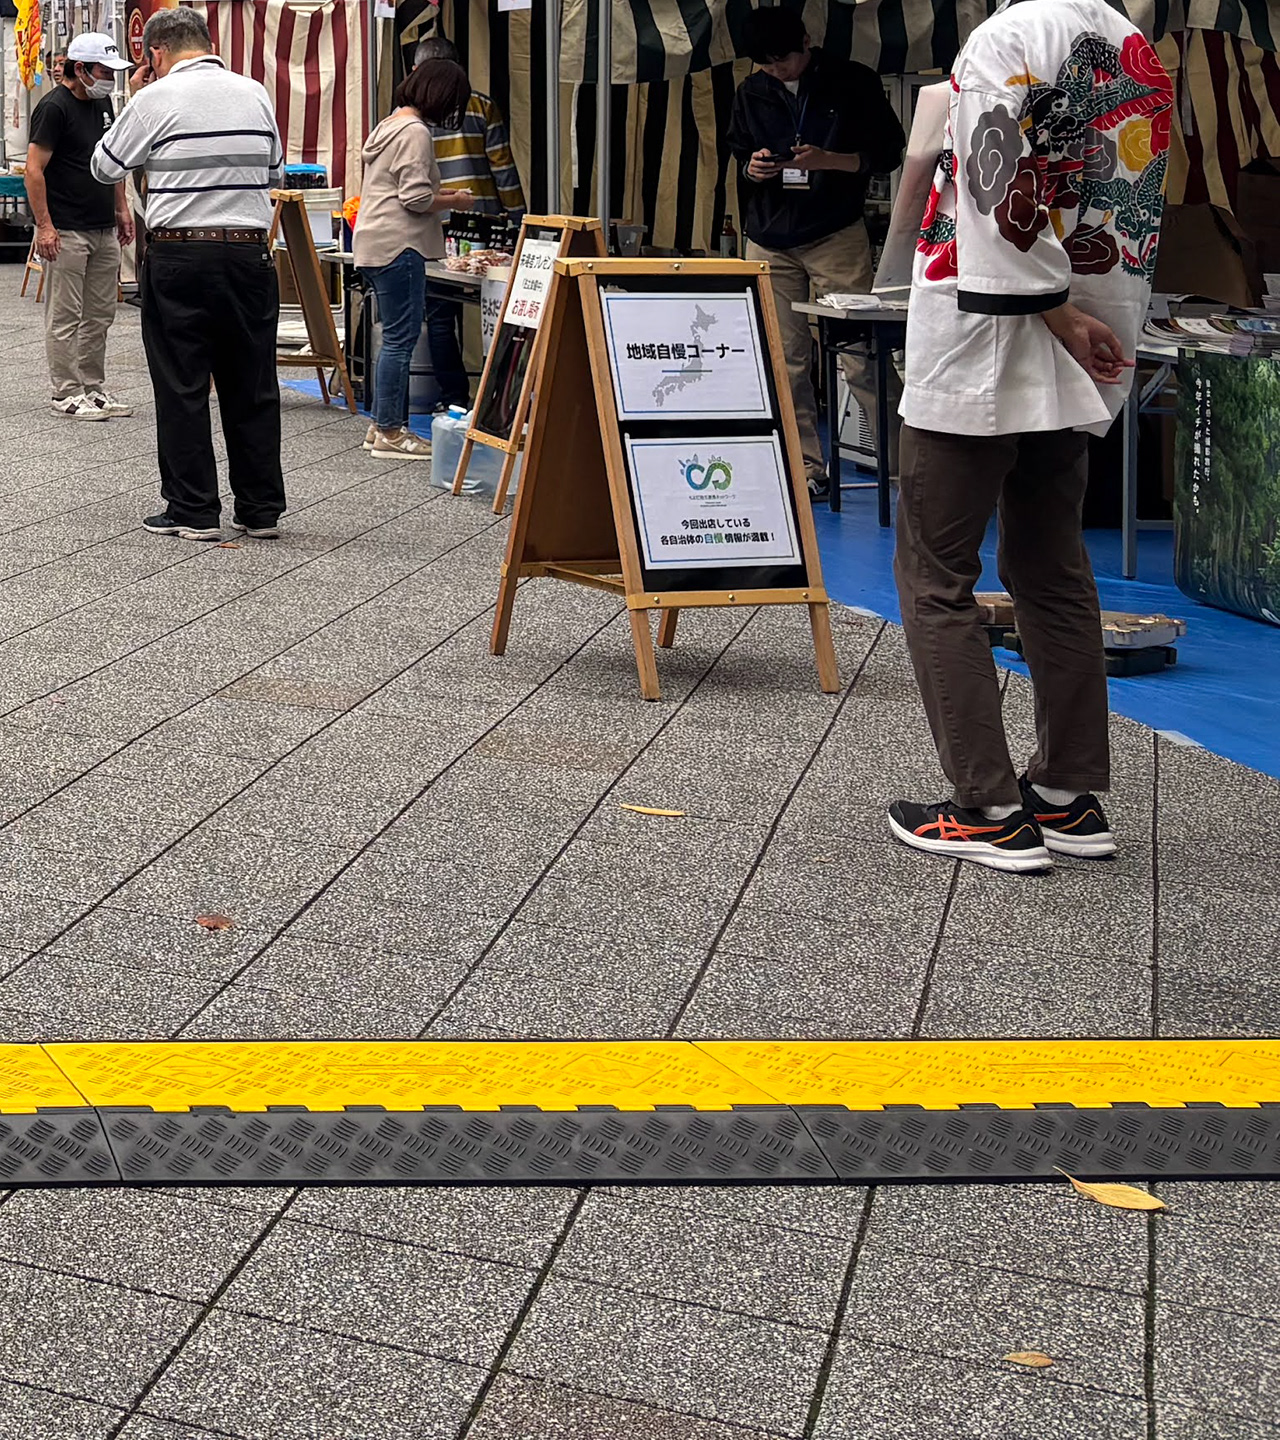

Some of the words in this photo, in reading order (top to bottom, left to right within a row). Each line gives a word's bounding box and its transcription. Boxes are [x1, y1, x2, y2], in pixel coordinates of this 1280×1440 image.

[627, 343, 745, 360] 地域自慢コーナー
[681, 518, 751, 529] 今回出店している
